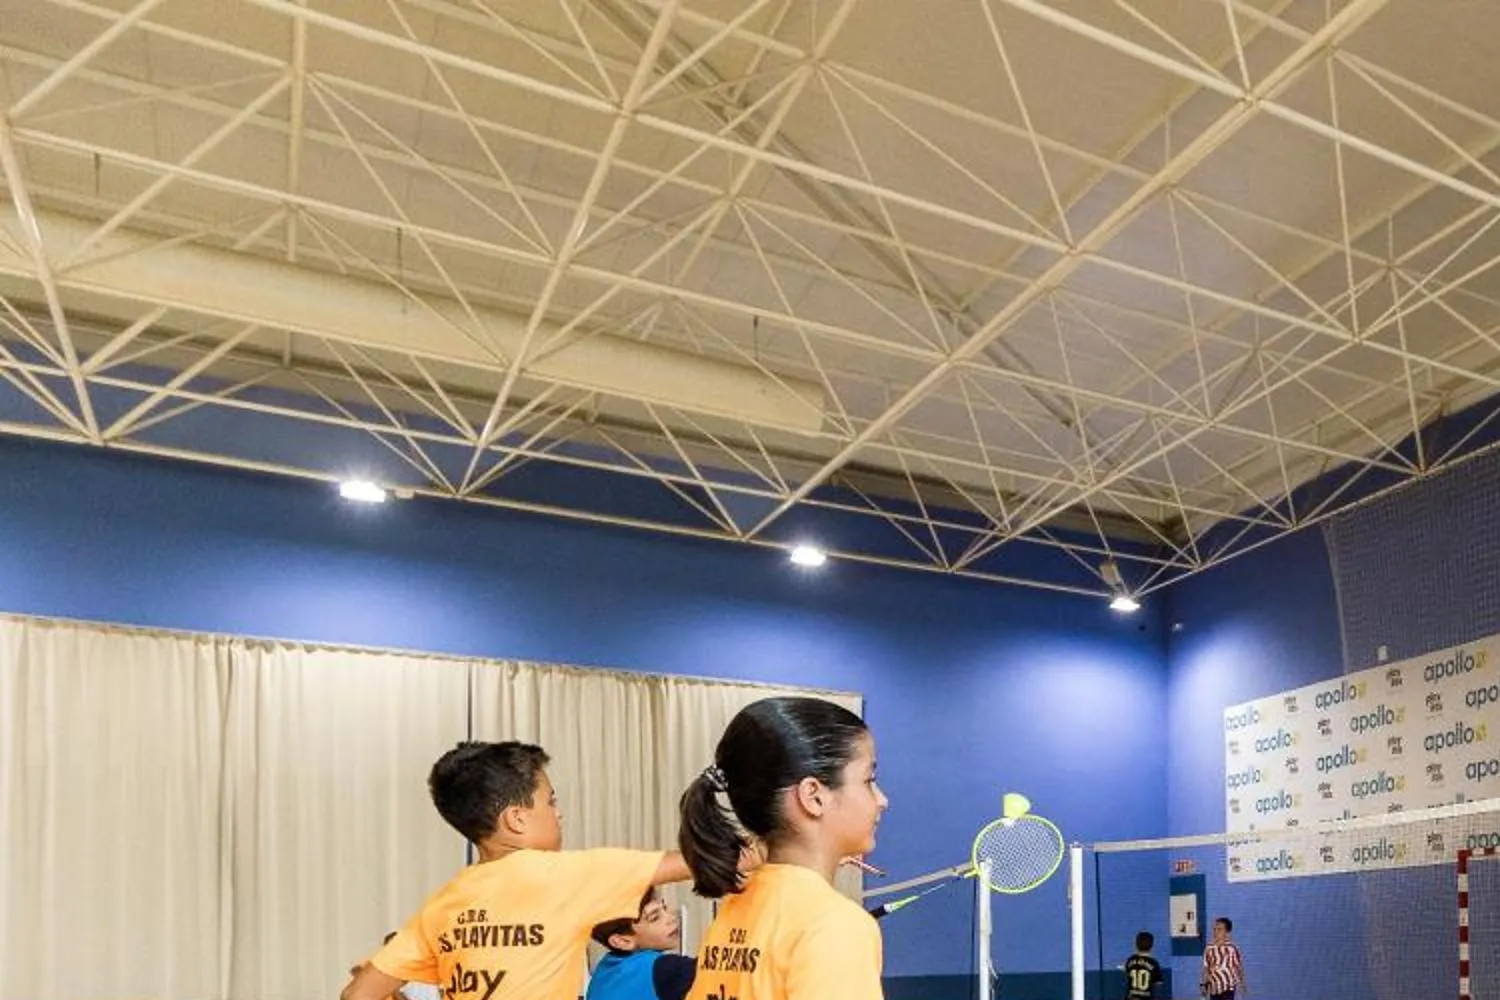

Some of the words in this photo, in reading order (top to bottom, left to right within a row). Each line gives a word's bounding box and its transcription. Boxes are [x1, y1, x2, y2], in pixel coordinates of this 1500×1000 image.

[1424, 650, 1475, 685] apollo
[1315, 680, 1357, 711] apollo
[1350, 704, 1395, 734] apollo
[1424, 721, 1475, 754] apollo
[1315, 744, 1357, 774] apollo
[1351, 770, 1395, 799] apollo
[1255, 790, 1292, 814] apollo
[1255, 849, 1293, 873] apollo
[1352, 837, 1395, 864] apollo
[1129, 969, 1151, 991] 10
